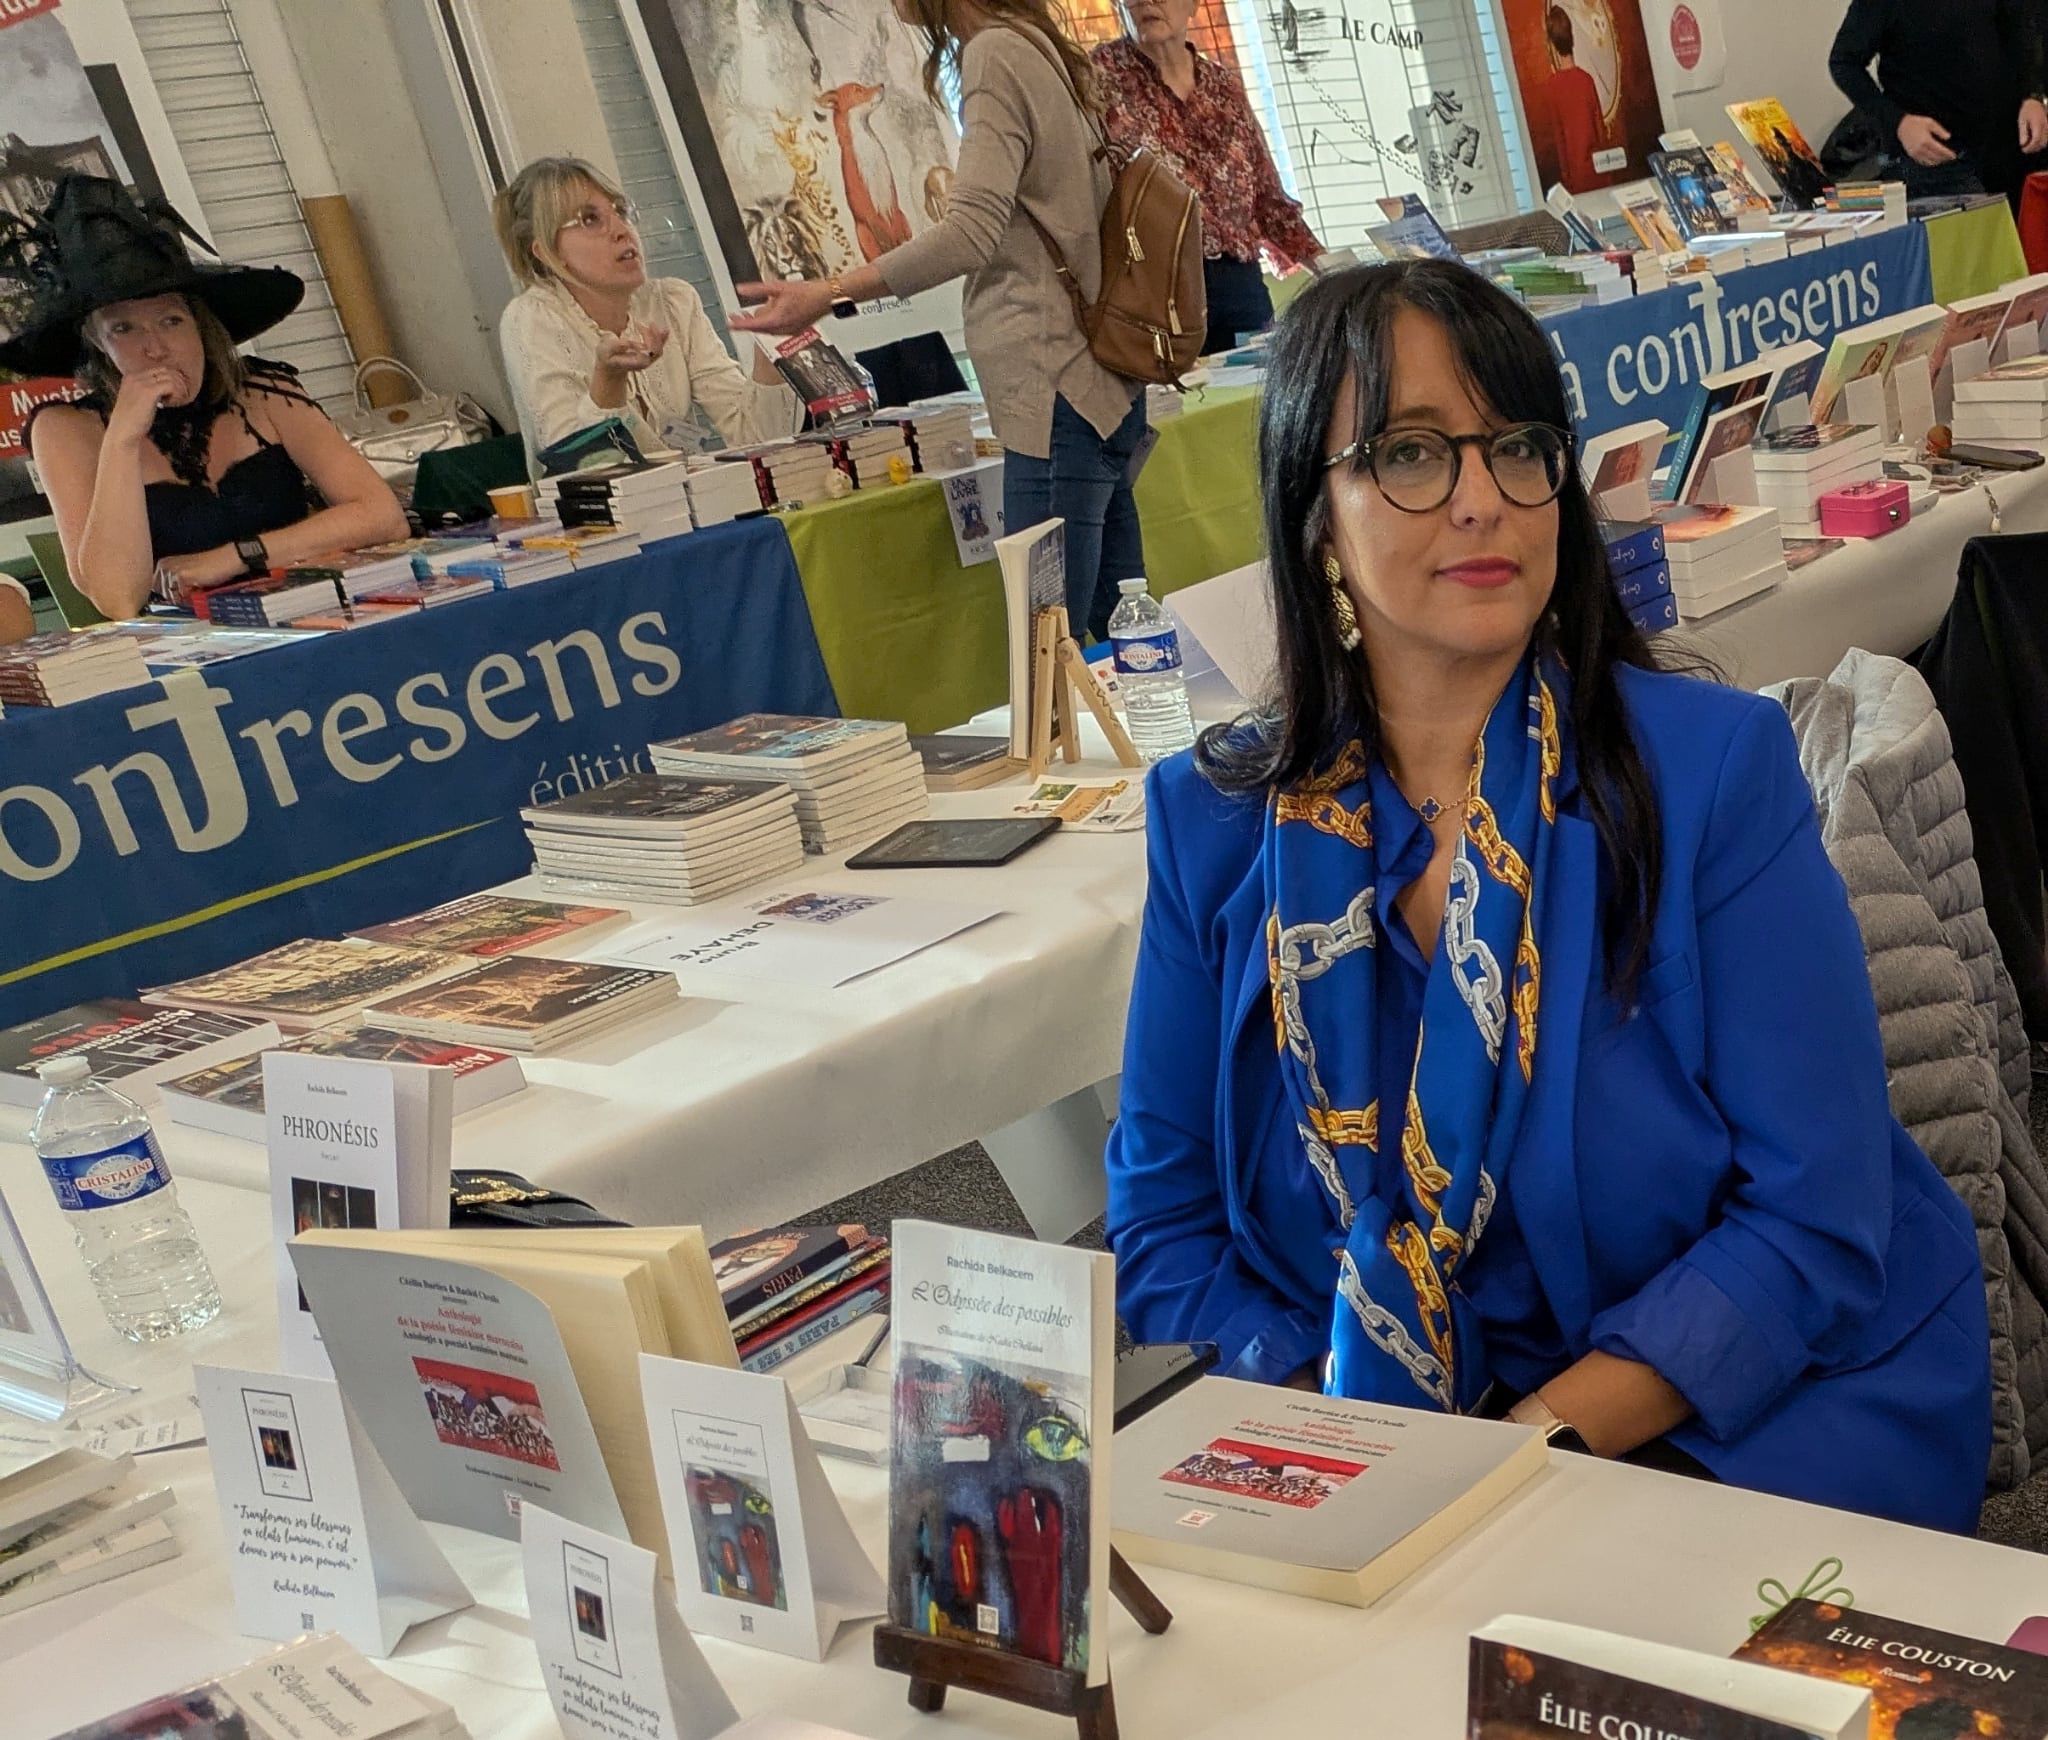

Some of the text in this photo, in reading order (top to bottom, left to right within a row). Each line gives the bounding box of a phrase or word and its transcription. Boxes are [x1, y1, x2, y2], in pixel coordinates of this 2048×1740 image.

[1341, 18, 1424, 51] LE CAMP
[670, 920, 775, 963] DEHAYE
[282, 1114, 379, 1149] PHRONÉSIS
[78, 1160, 152, 1190] CRISTALINE
[761, 1264, 805, 1300] PARIS
[946, 1255, 1035, 1282] Rachida Belkacem
[438, 1307, 482, 1325] Anthologie
[911, 1280, 1074, 1329] L'Odyssée des possibles
[1826, 1626, 2017, 1684] ÉLIE COUSTON
[1539, 1692, 1593, 1735] ÉLIE
